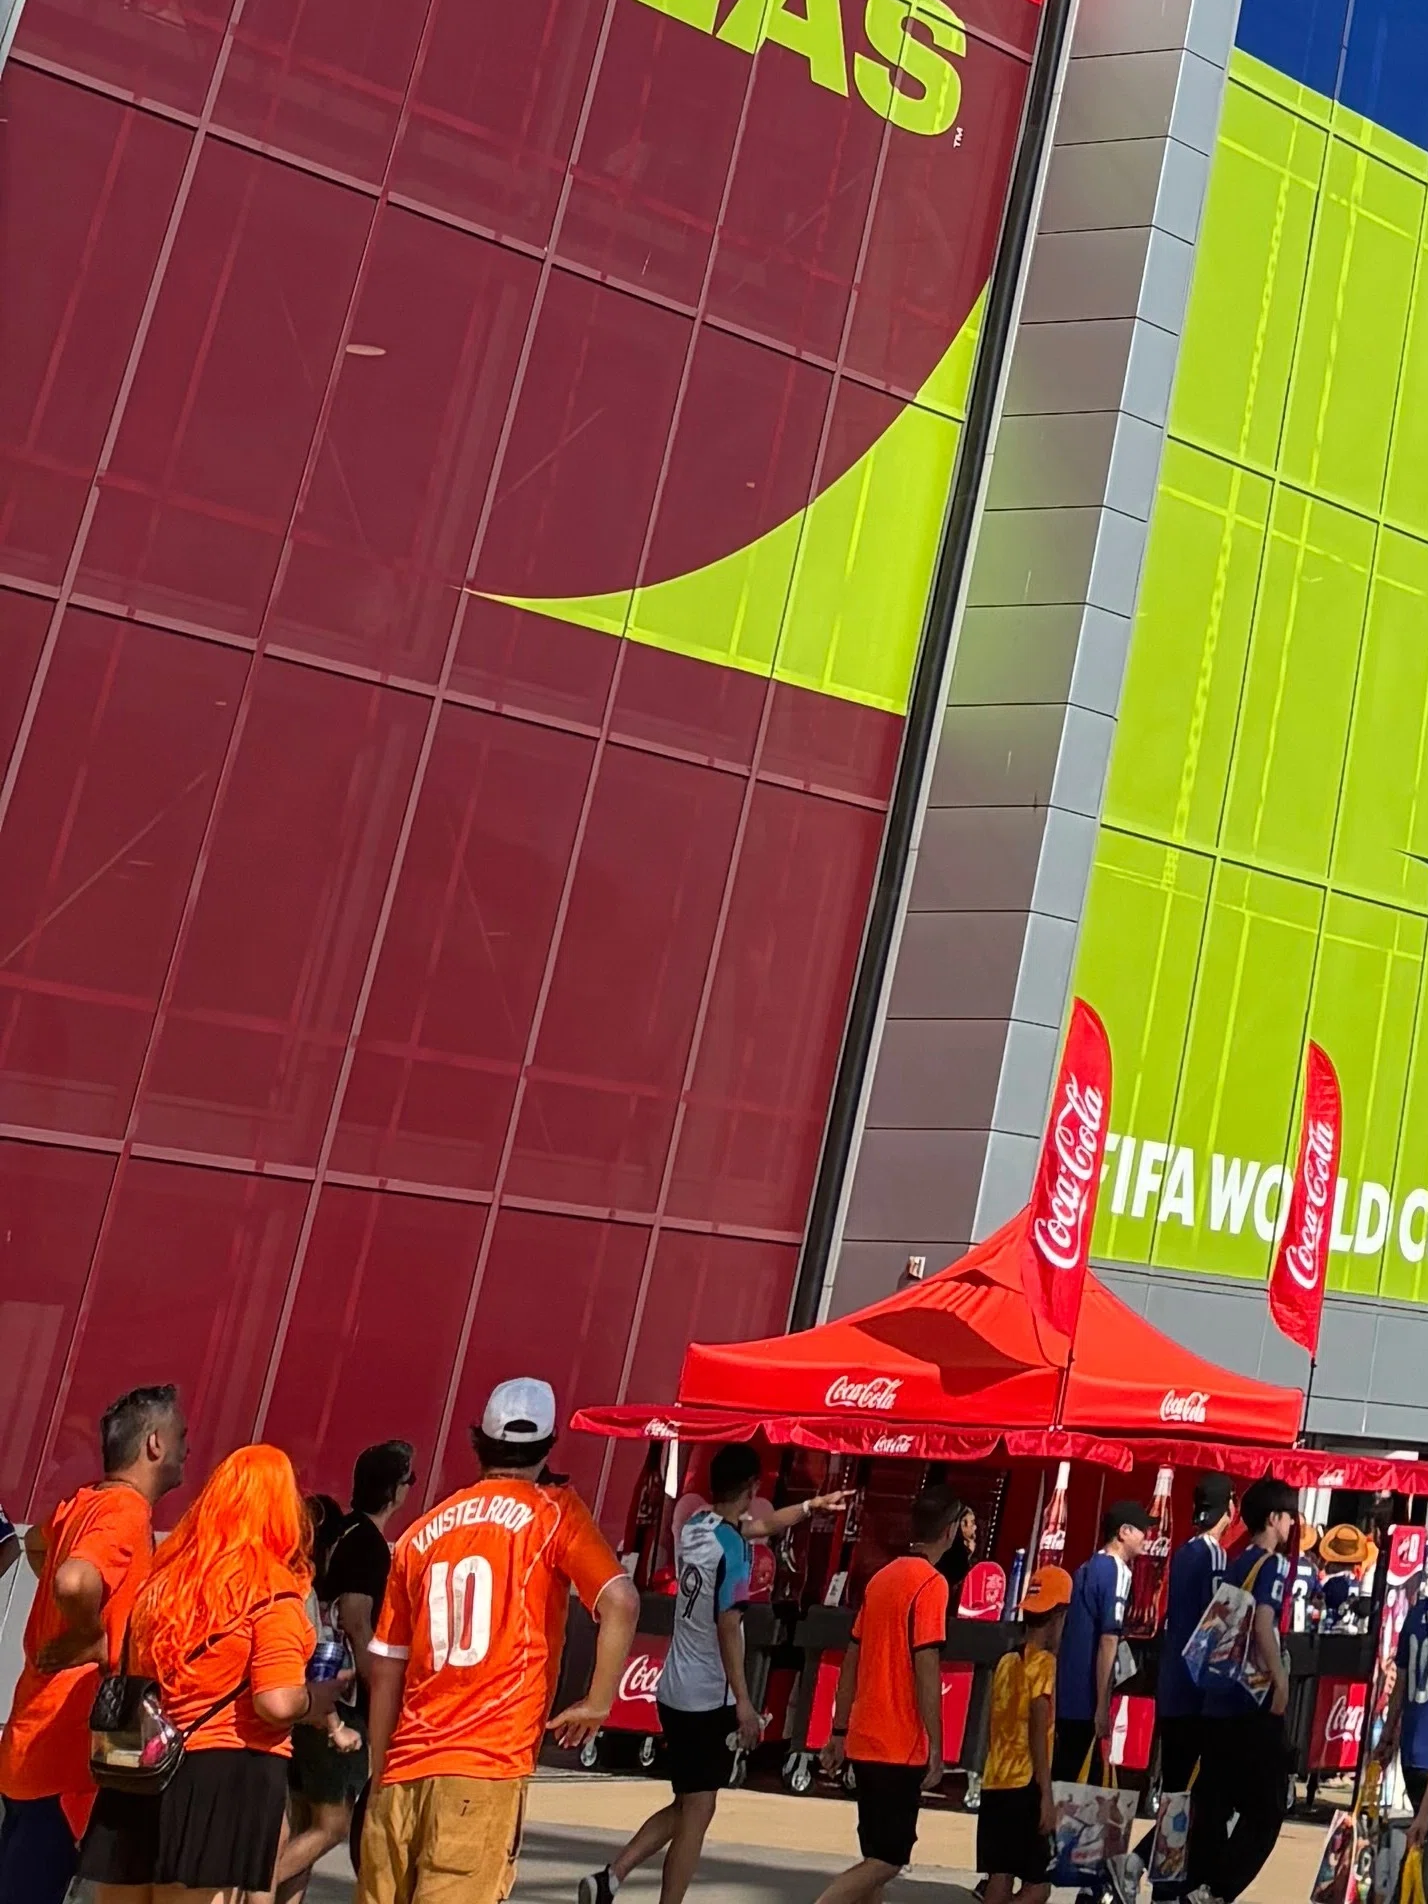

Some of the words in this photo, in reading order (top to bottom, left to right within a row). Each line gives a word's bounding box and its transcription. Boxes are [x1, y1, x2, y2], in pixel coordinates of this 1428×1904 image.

[1209, 1152, 1391, 1256] WOLD
[824, 1374, 904, 1411] Coca-Cola
[427, 1554, 494, 1672] 10
[679, 1562, 703, 1620] 9
